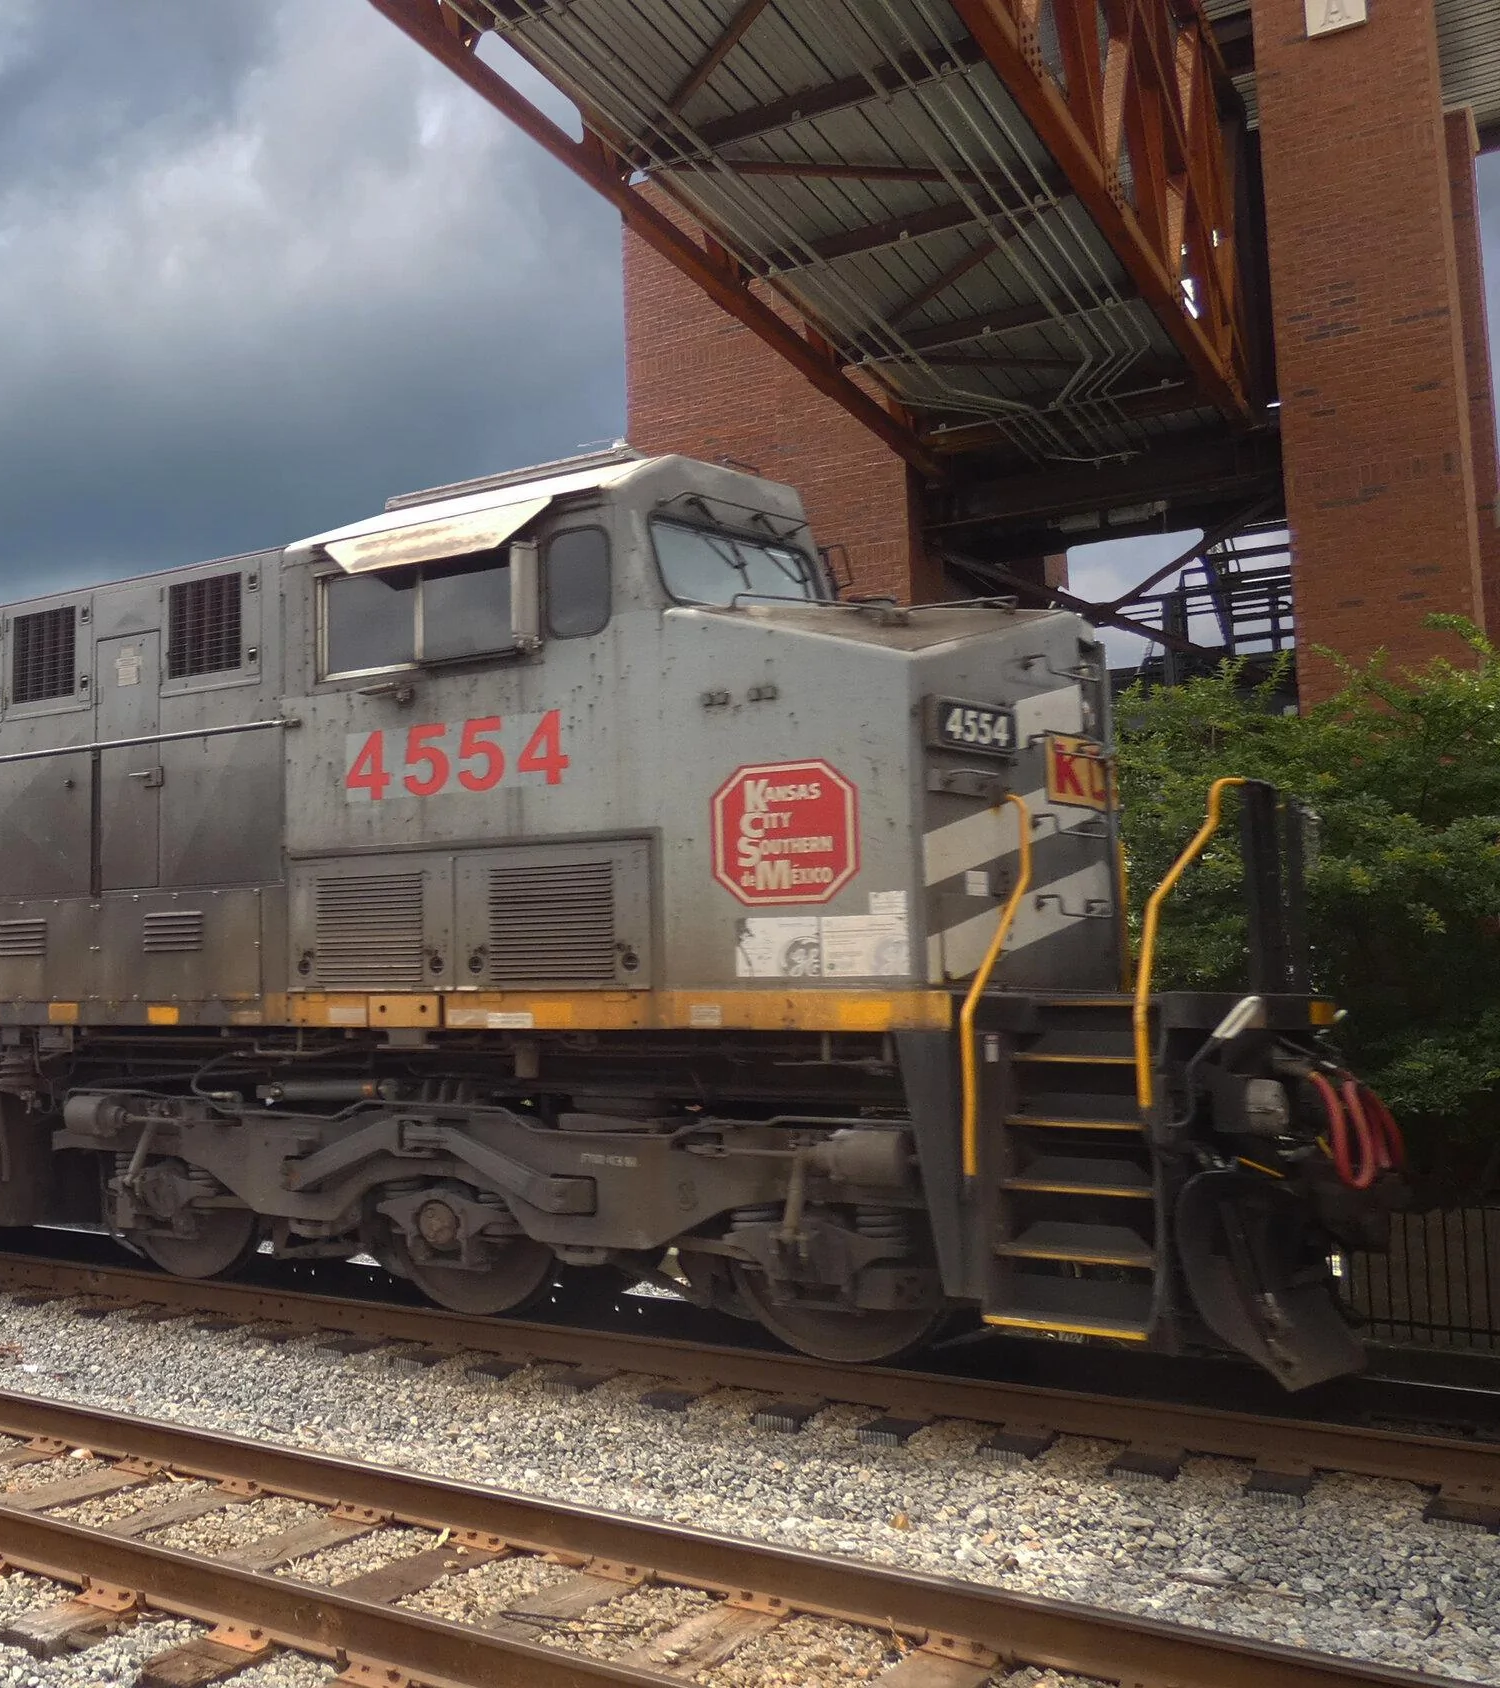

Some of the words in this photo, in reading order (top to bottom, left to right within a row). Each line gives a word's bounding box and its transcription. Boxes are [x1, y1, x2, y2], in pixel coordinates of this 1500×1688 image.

[945, 708, 1011, 747] 4554
[345, 709, 571, 801] 4554
[744, 779, 822, 812] KANSAS
[740, 812, 793, 839] CITY
[737, 836, 834, 868] SOUTHERN
